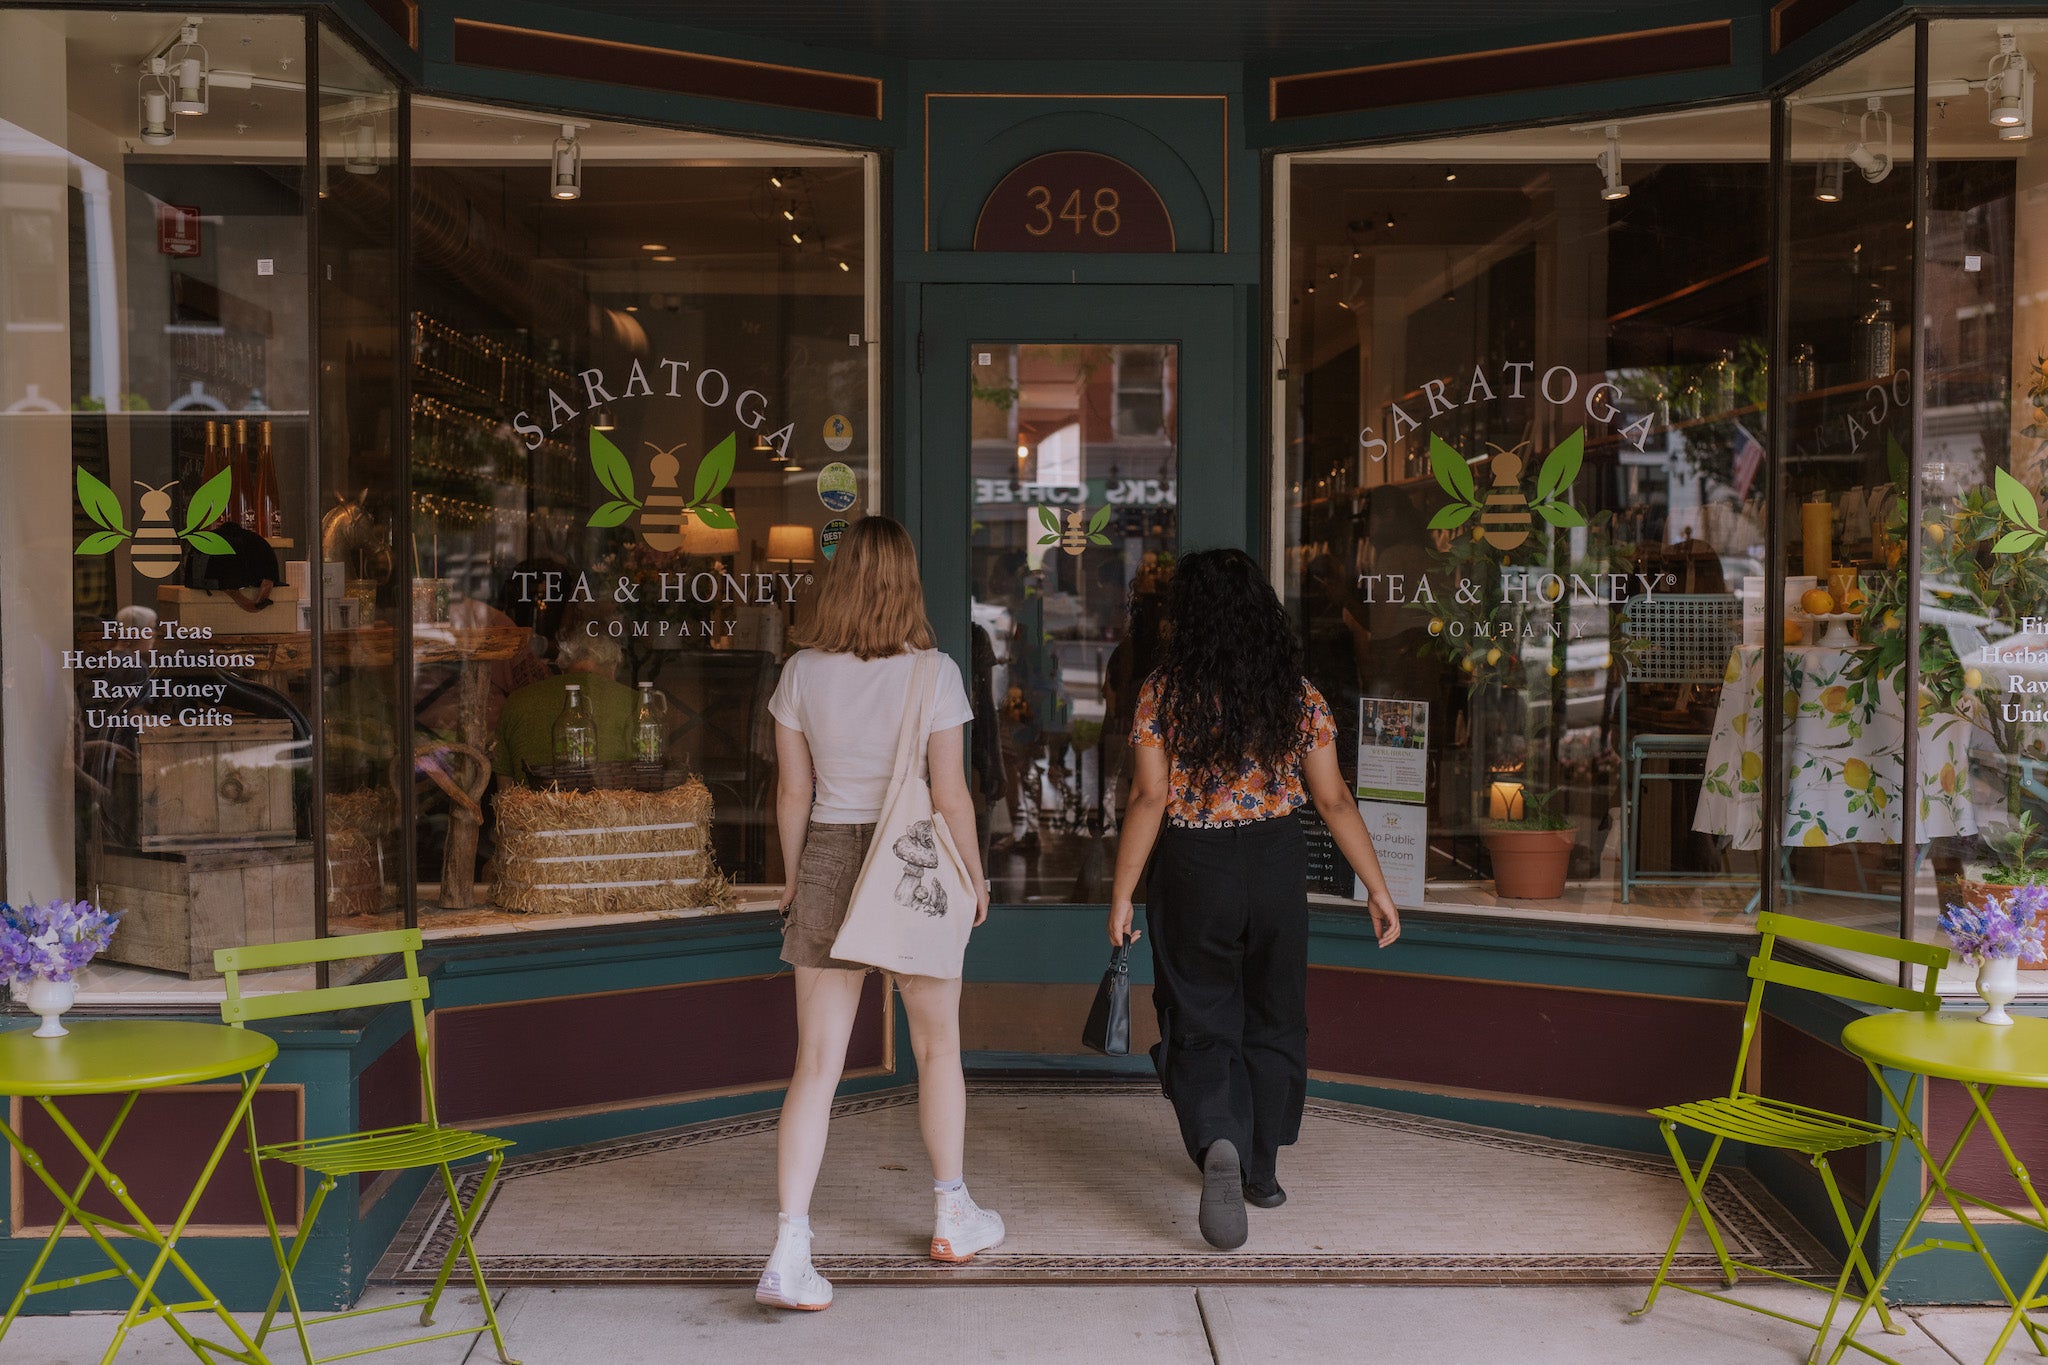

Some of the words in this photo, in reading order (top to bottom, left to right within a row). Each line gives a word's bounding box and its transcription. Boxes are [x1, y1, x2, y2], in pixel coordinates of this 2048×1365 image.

[1025, 185, 1121, 237] 348
[512, 357, 796, 459] SARATOGA
[1359, 359, 1656, 463] SARATOGA
[512, 570, 596, 604] TEA
[613, 576, 641, 604] &
[1358, 573, 1437, 605] TEA
[1455, 577, 1482, 605] &
[101, 620, 153, 640] Fine
[160, 620, 213, 640] Teas
[586, 620, 738, 638] COMPANY
[1428, 620, 1589, 639] COMPANY
[62, 649, 142, 669] Herbal
[148, 648, 256, 669] Infusions
[92, 679, 143, 699] Raw
[150, 678, 227, 703] Honey
[86, 709, 172, 734] Unique
[178, 708, 233, 728] Gifts
[1385, 833, 1416, 846] Public
